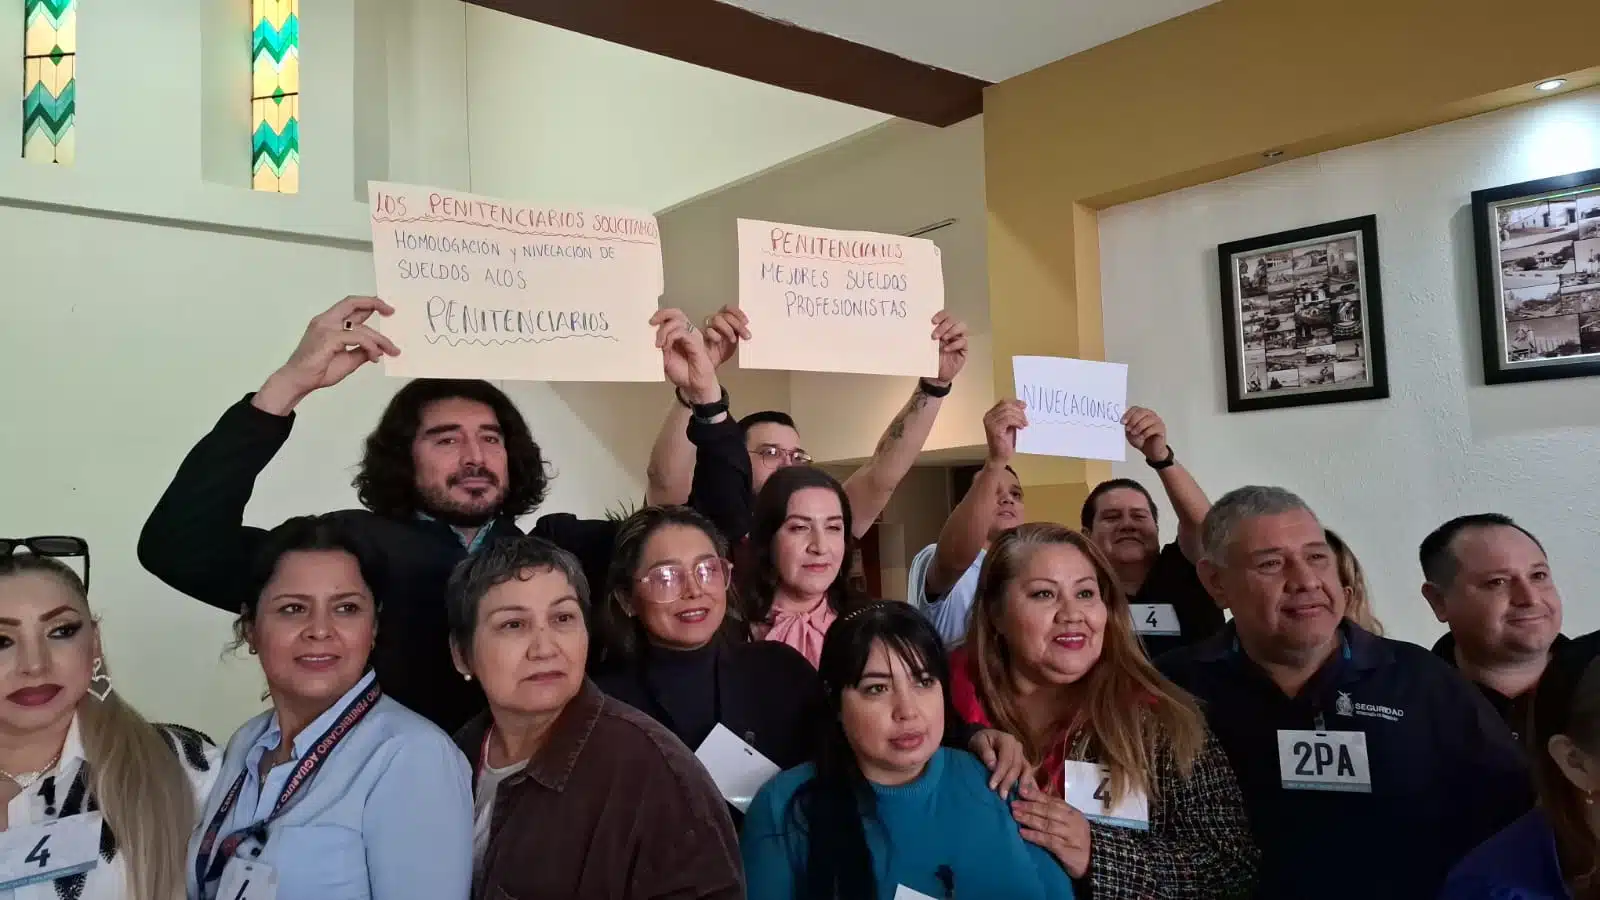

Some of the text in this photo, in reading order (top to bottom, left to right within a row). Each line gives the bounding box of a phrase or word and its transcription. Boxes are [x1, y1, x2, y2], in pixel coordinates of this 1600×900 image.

[376, 192, 407, 217] LOS
[429, 193, 585, 228] PENITENCIARIOS
[600, 246, 616, 259] DE
[770, 227, 903, 258] PENITENCIARIOS
[398, 258, 470, 282] SUELDOS
[760, 262, 907, 291] MEJORES SUELDOS
[426, 295, 609, 334] PENITENCIARIOS
[785, 290, 907, 319] PROFESIONISTAS
[1023, 384, 1120, 423] NIVELACIONES
[1146, 610, 1158, 628] 4
[1355, 702, 1404, 718] SEGURIDAD
[280, 701, 369, 803] PENITENCIARIO AGUARUTO
[1293, 741, 1356, 777] 2PA
[25, 834, 52, 868] 4
